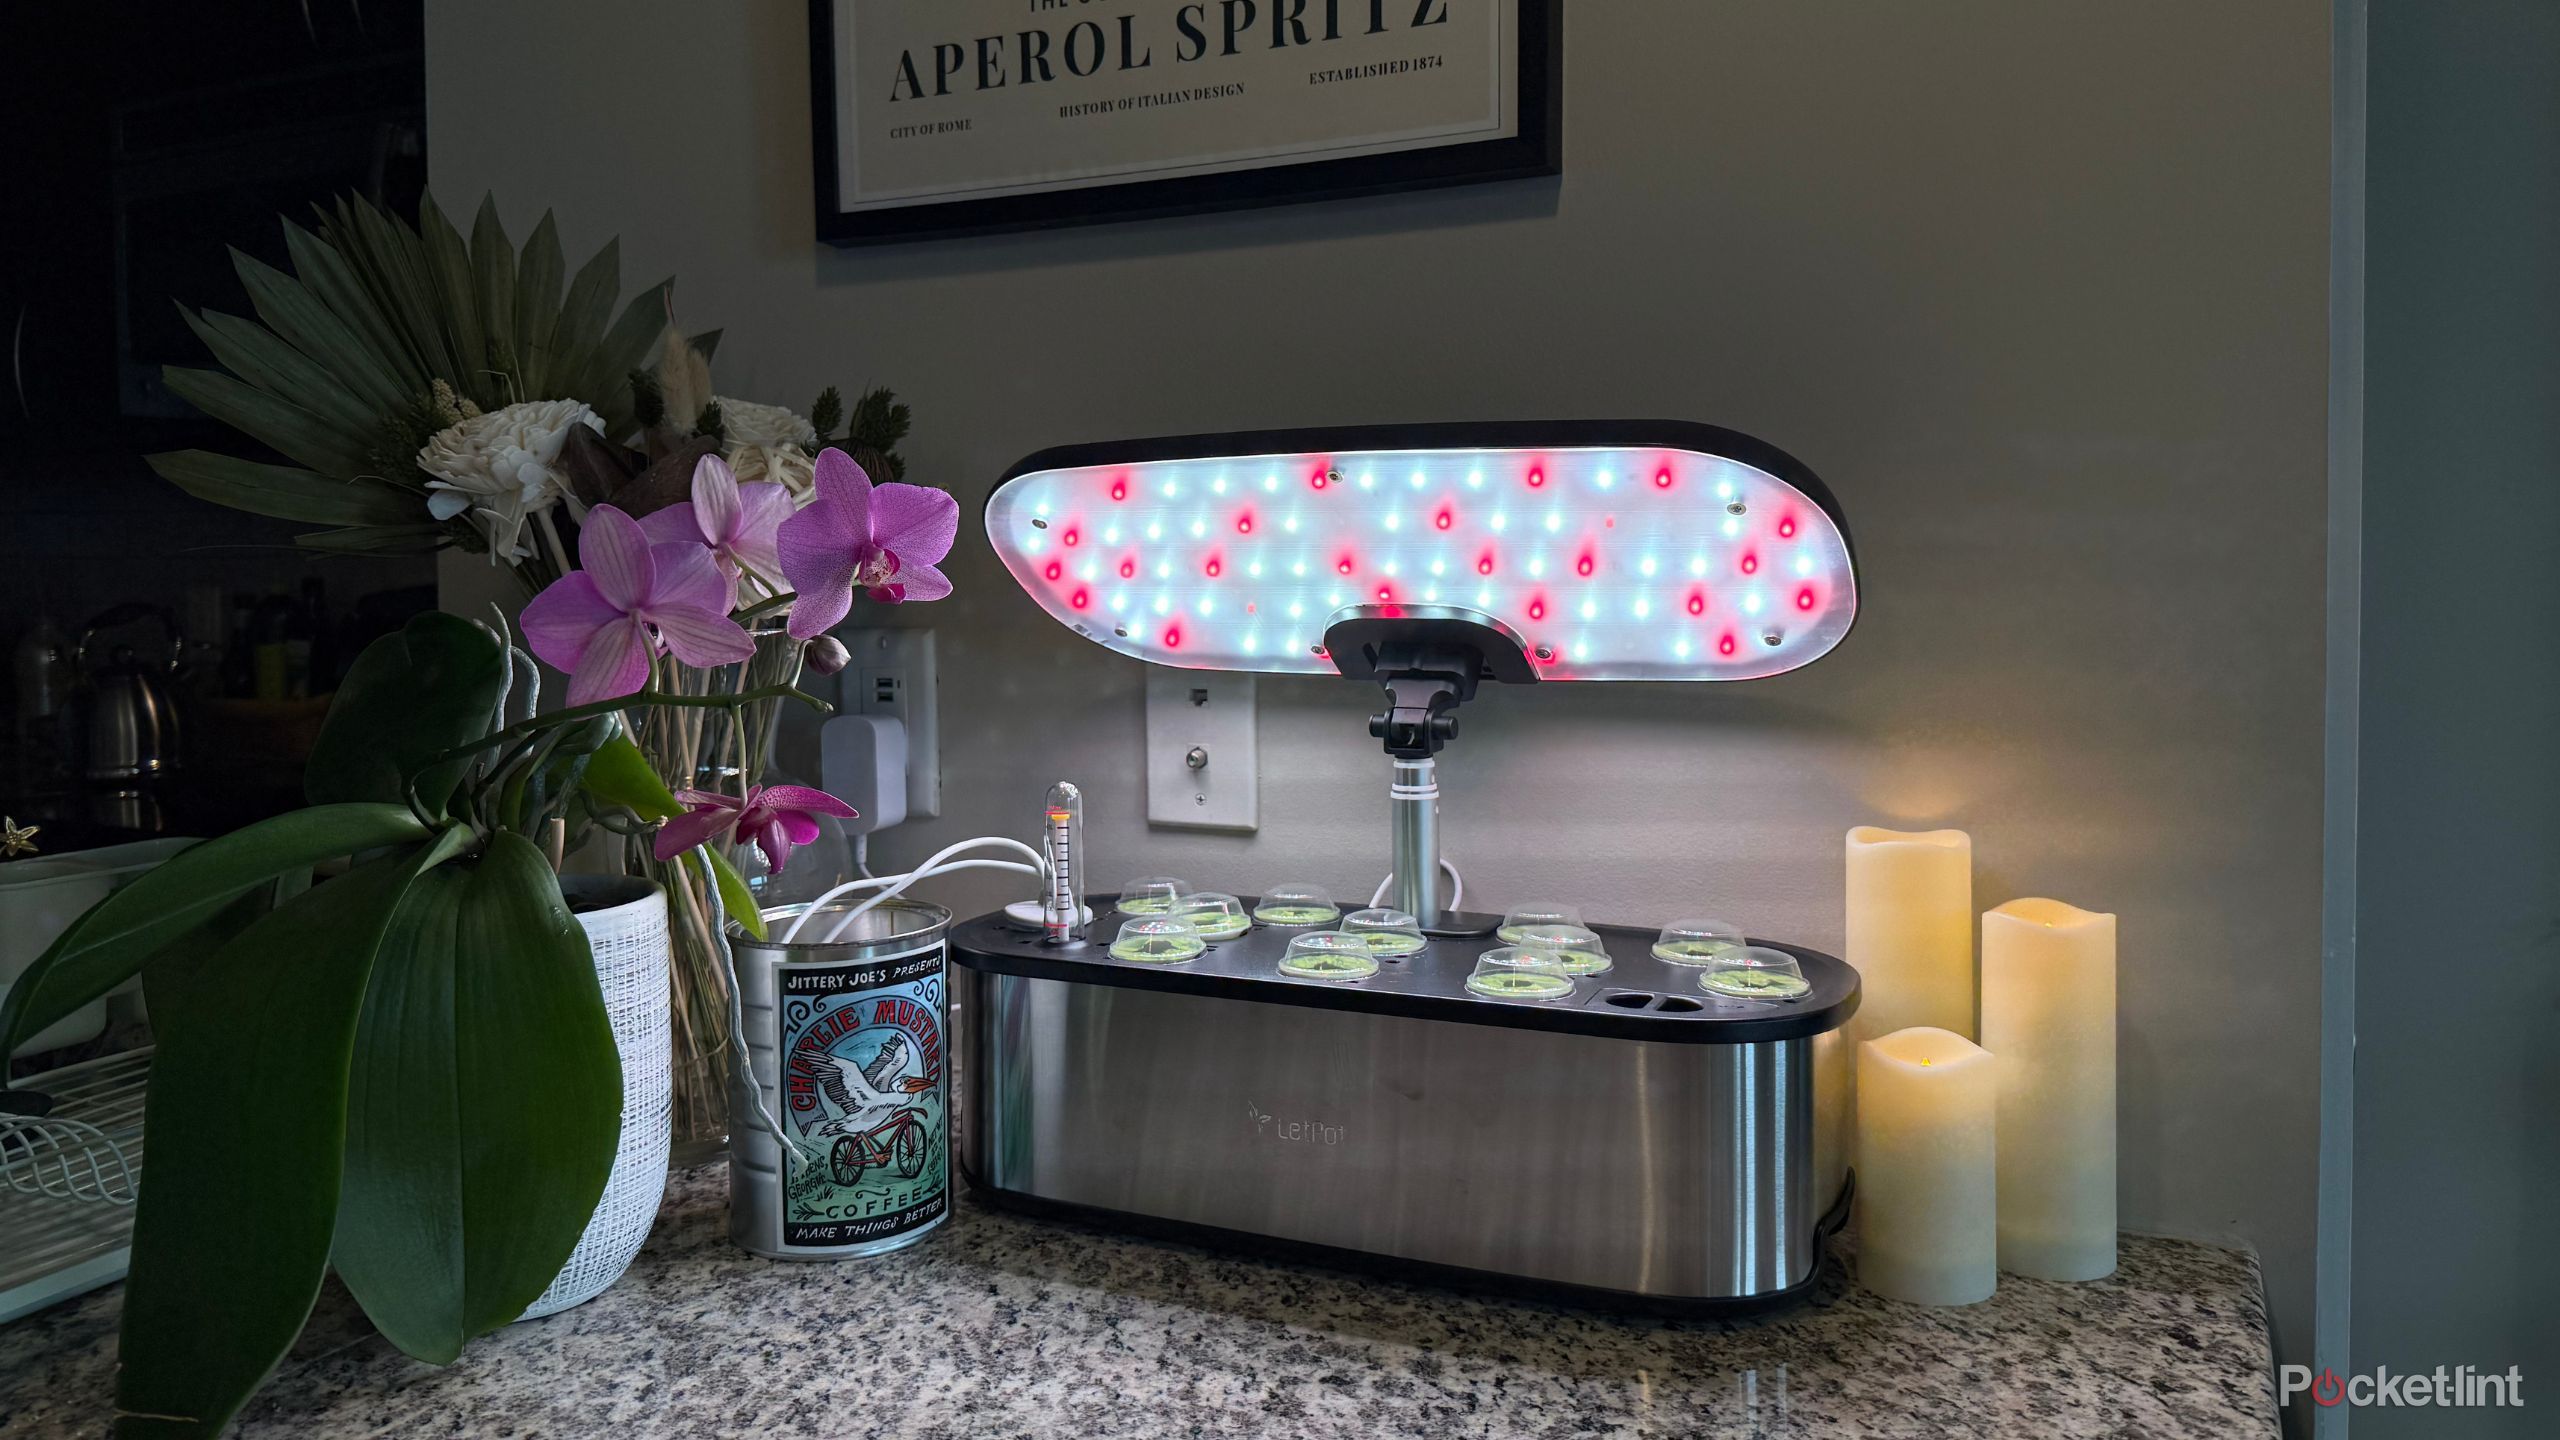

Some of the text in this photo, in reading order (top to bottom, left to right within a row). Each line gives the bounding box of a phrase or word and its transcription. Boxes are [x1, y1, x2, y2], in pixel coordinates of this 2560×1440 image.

[889, 14, 1151, 102] APEROL
[1309, 55, 1444, 85] ESTABLISHED 1874
[1060, 82, 1246, 118] HISTORY OF ITALIAN DESIGN
[890, 119, 972, 139] CITY OF ROME
[788, 955, 941, 990] JITTERY JOE'S PRESENTS
[789, 1000, 943, 1112] CHARLIE MUSTARD
[1277, 1117, 1344, 1146] LetPot
[795, 1197, 942, 1240] MAKE THINGS BETTER
[825, 1186, 922, 1219] COFFEE
